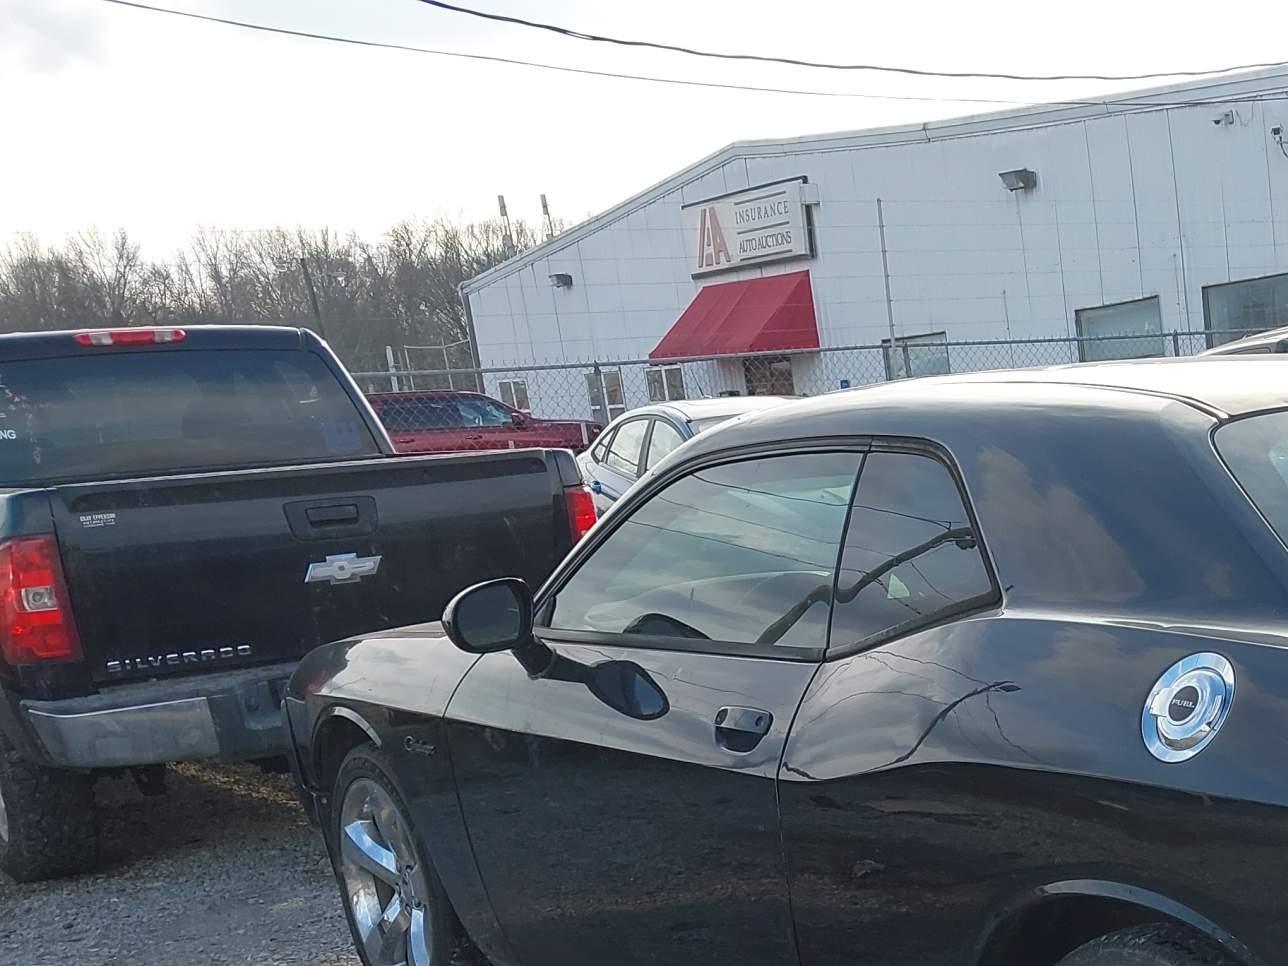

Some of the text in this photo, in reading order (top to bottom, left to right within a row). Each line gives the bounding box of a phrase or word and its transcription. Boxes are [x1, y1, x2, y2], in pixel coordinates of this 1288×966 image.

[735, 200, 789, 225] INSURANCE
[106, 644, 251, 673] SILVERADO
[1171, 698, 1195, 709] FUEL
